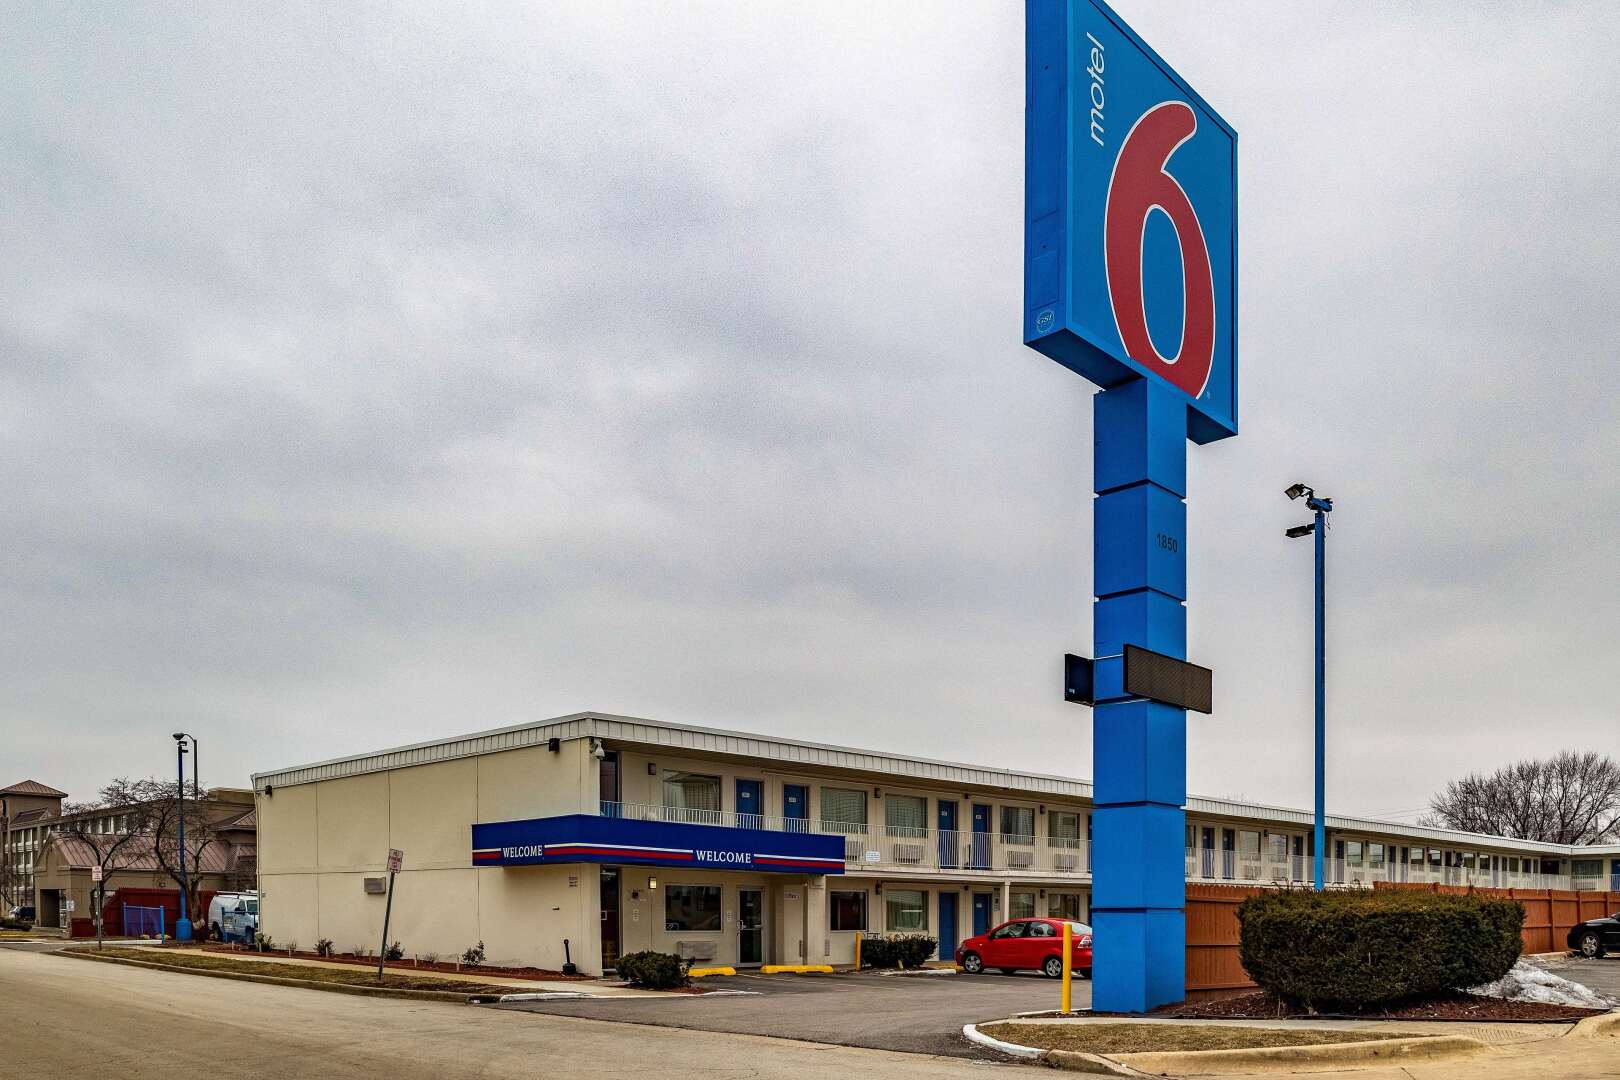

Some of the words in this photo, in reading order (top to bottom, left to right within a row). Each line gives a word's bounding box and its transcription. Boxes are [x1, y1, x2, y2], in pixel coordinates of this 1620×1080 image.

[1086, 31, 1105, 145] motel
[1104, 100, 1216, 401] 6
[1156, 532, 1178, 553] 1850
[502, 845, 543, 859] WELCOME
[696, 849, 752, 864] WELCOME
